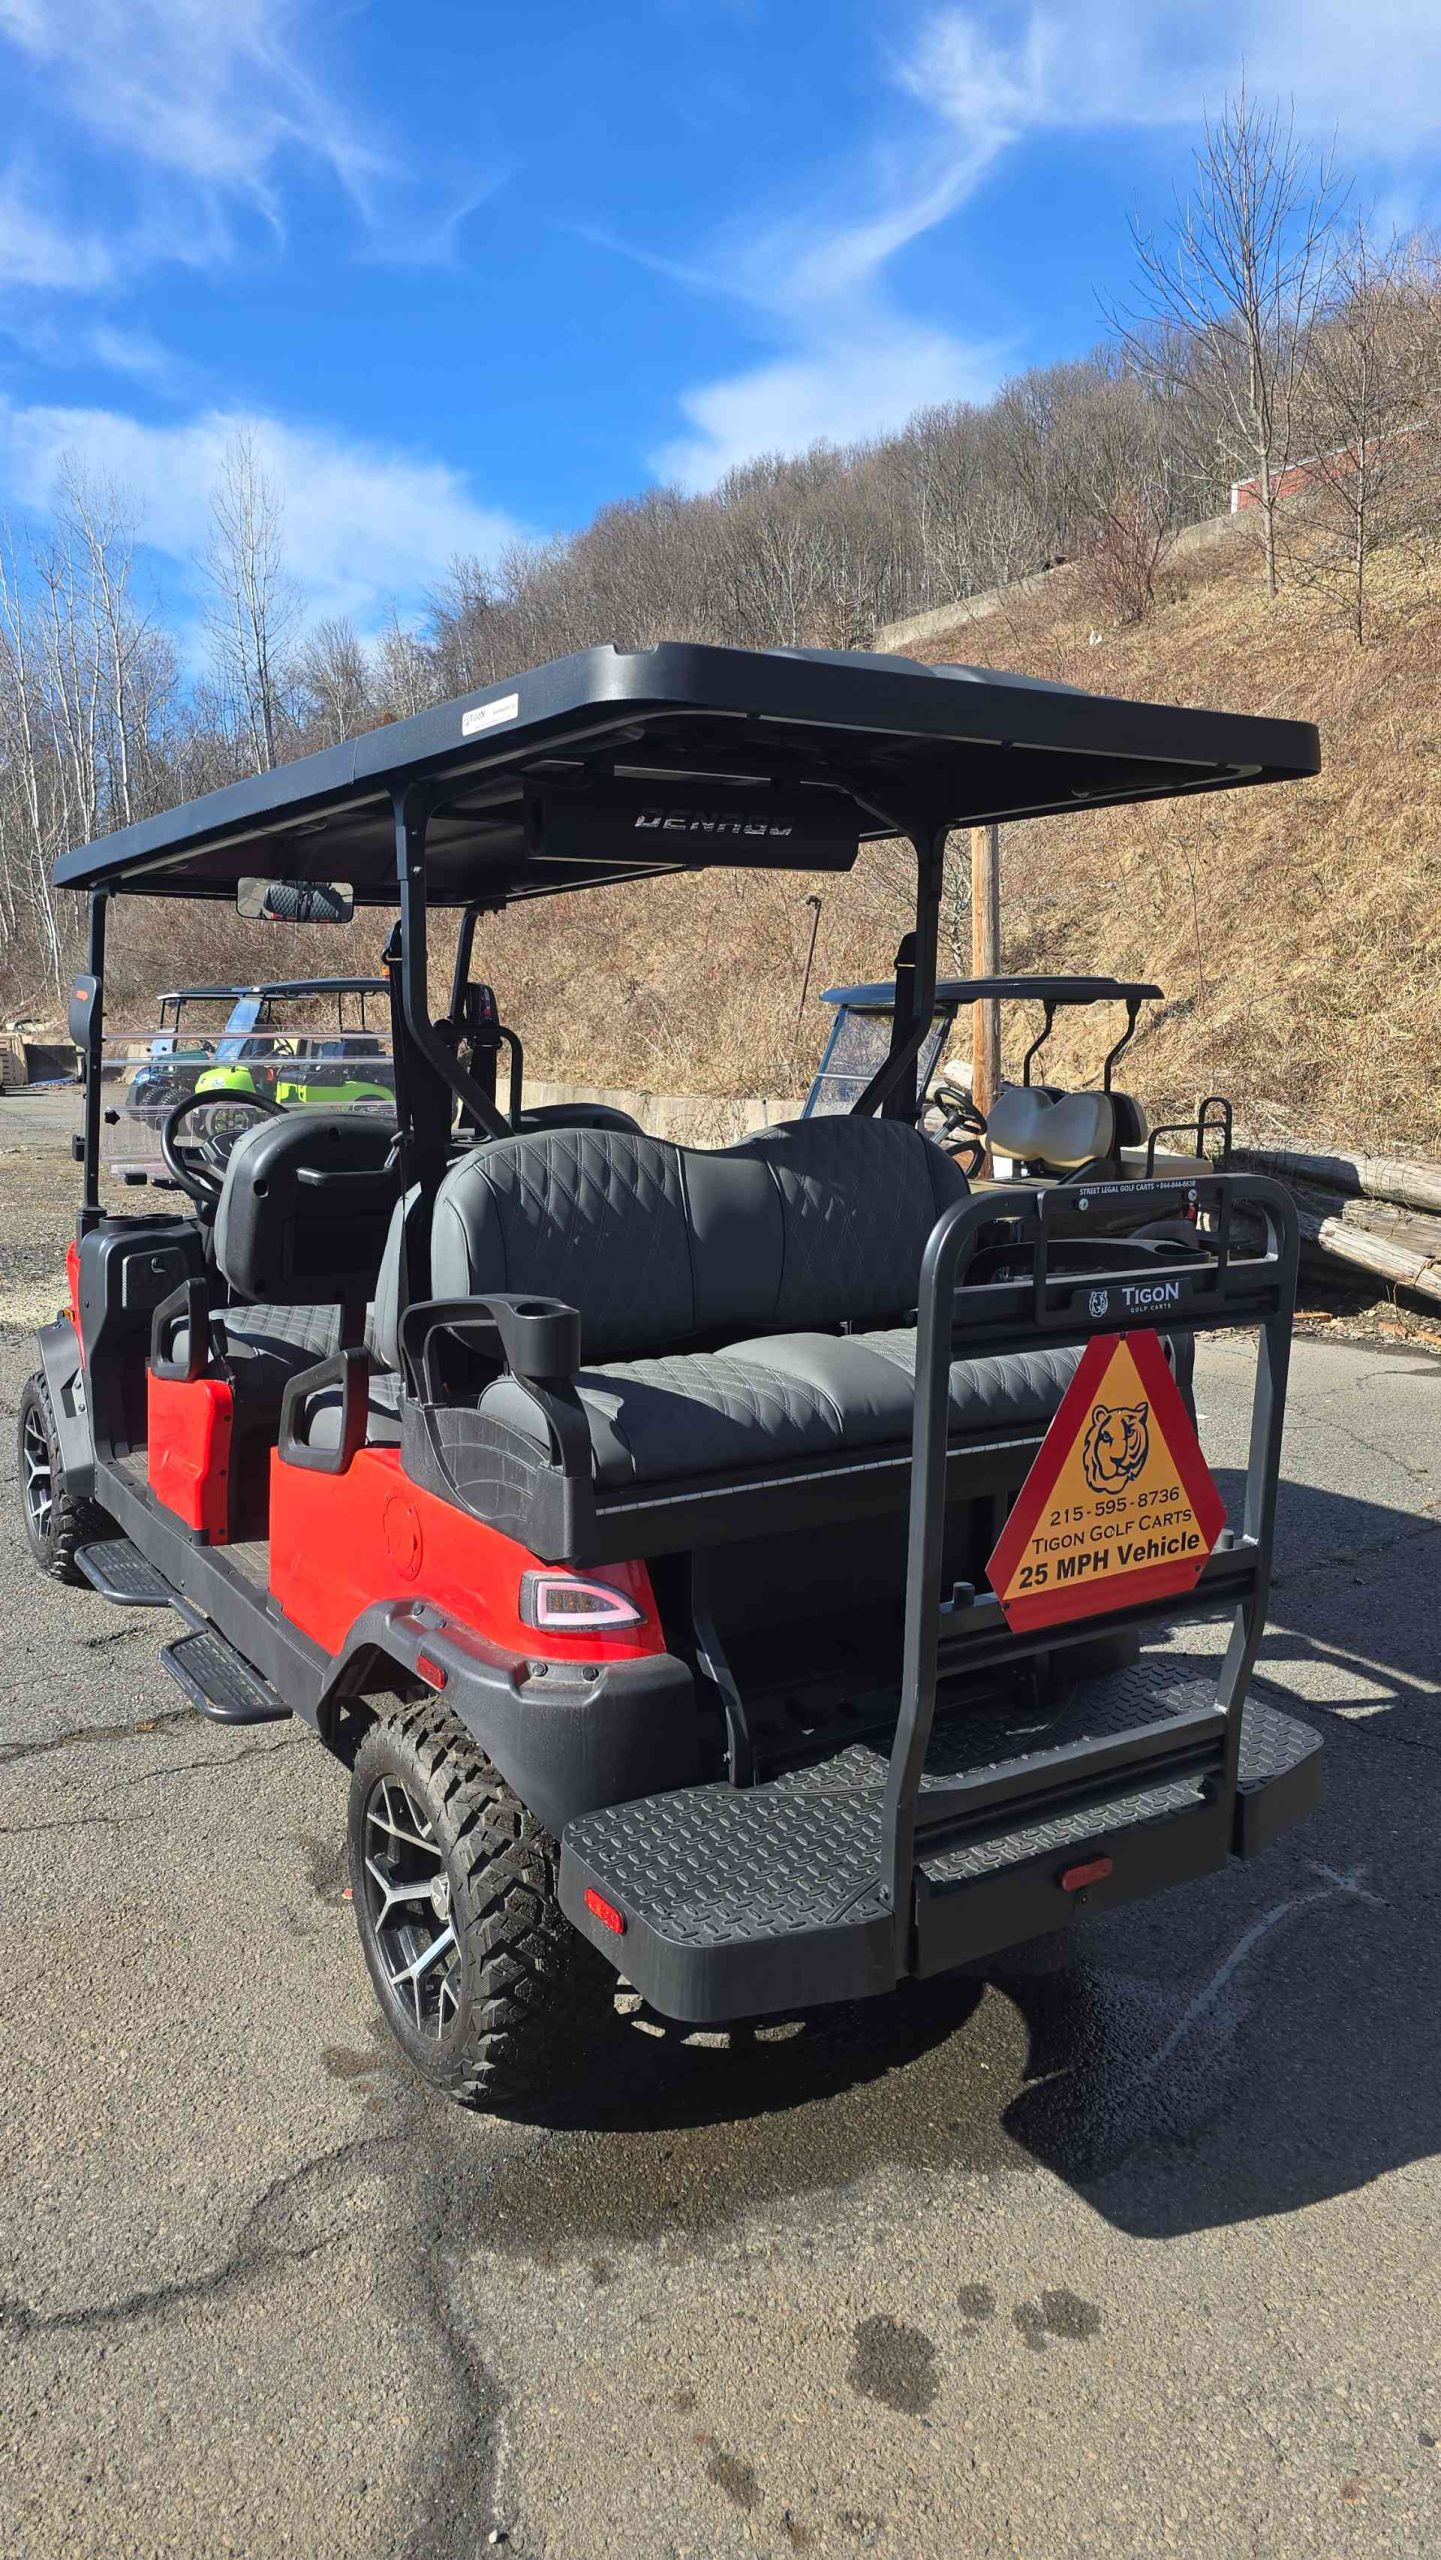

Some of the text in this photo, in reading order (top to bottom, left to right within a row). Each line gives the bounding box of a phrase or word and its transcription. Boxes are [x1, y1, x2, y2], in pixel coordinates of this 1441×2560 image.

[1079, 1187, 1100, 1195] STREET
[1101, 1186, 1119, 1194] LEGAL
[1120, 1184, 1134, 1192] GOLF
[1136, 1183, 1155, 1191] CARTS
[1122, 1282, 1179, 1305] TIGON
[1150, 1303, 1171, 1311] CARTS
[1032, 1509, 1192, 1555] TIGON GOLF CARTS
[1018, 1531, 1200, 1589] 25 MPH Vehicle
